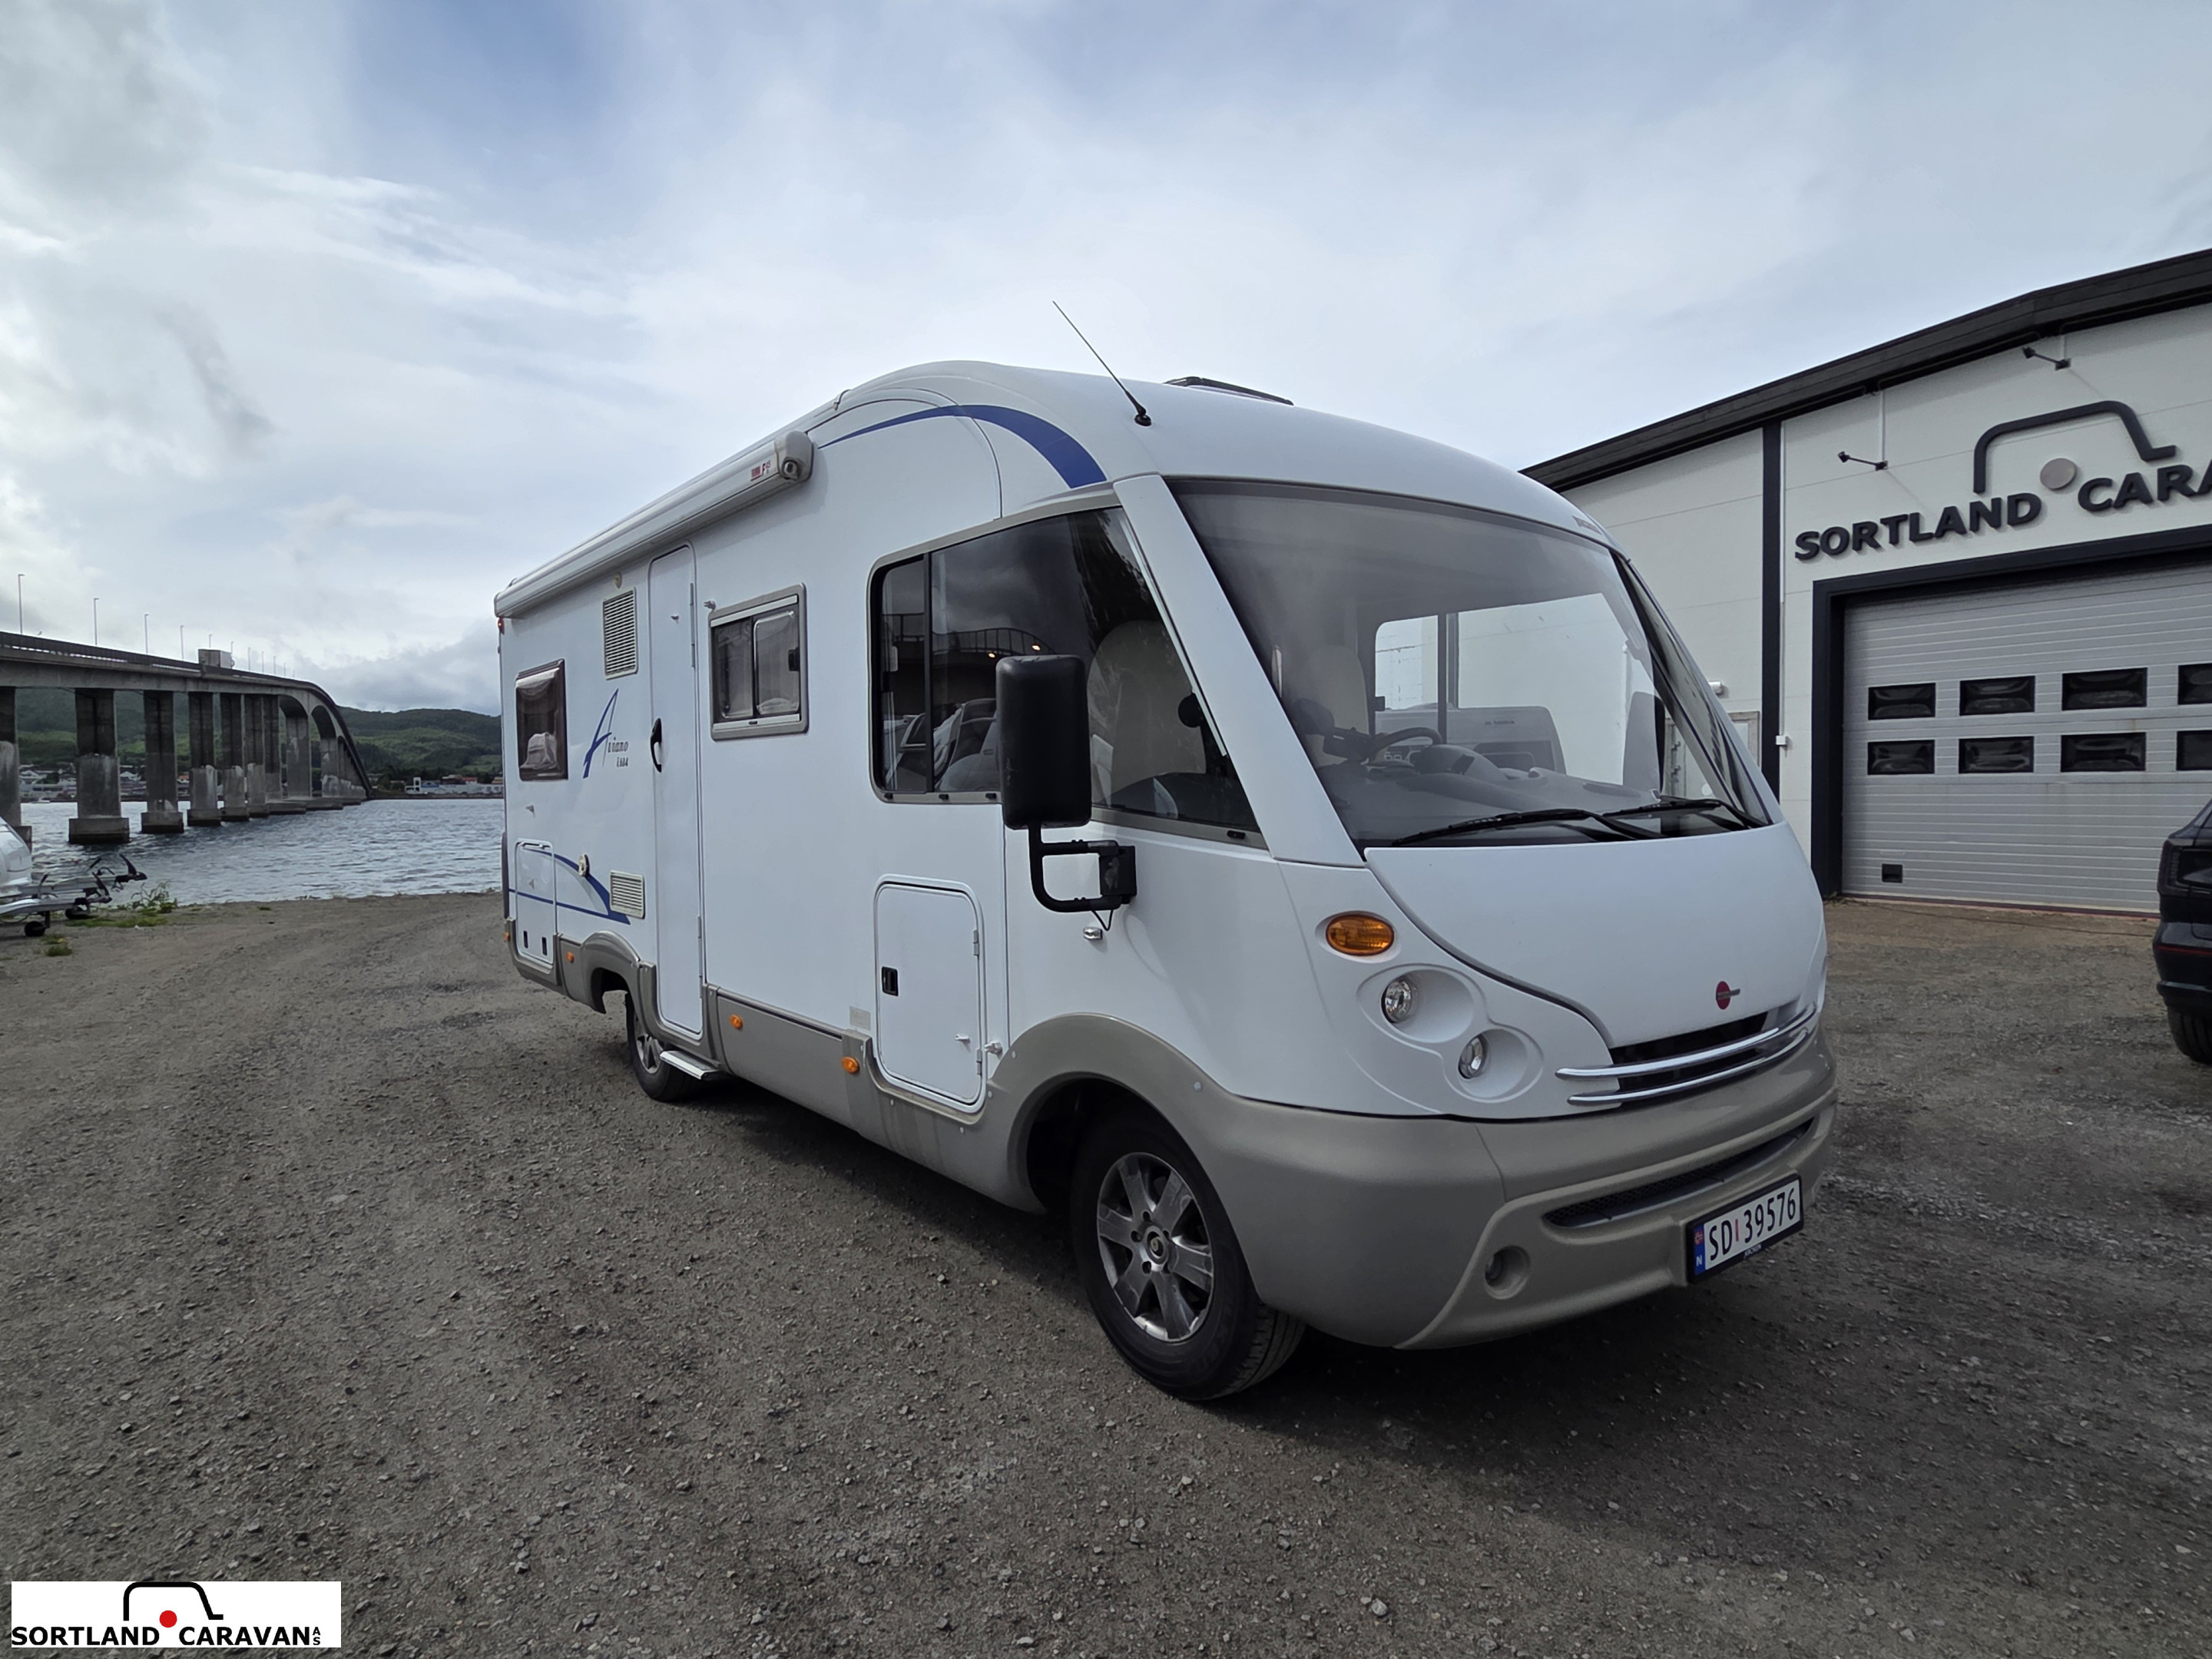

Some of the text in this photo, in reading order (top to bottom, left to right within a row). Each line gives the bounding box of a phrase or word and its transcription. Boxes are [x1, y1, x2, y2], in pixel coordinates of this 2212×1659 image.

[1795, 492, 2042, 560] SORTLAND
[1709, 1187, 1796, 1261] SD 39576
[1696, 1254, 1703, 1267] N
